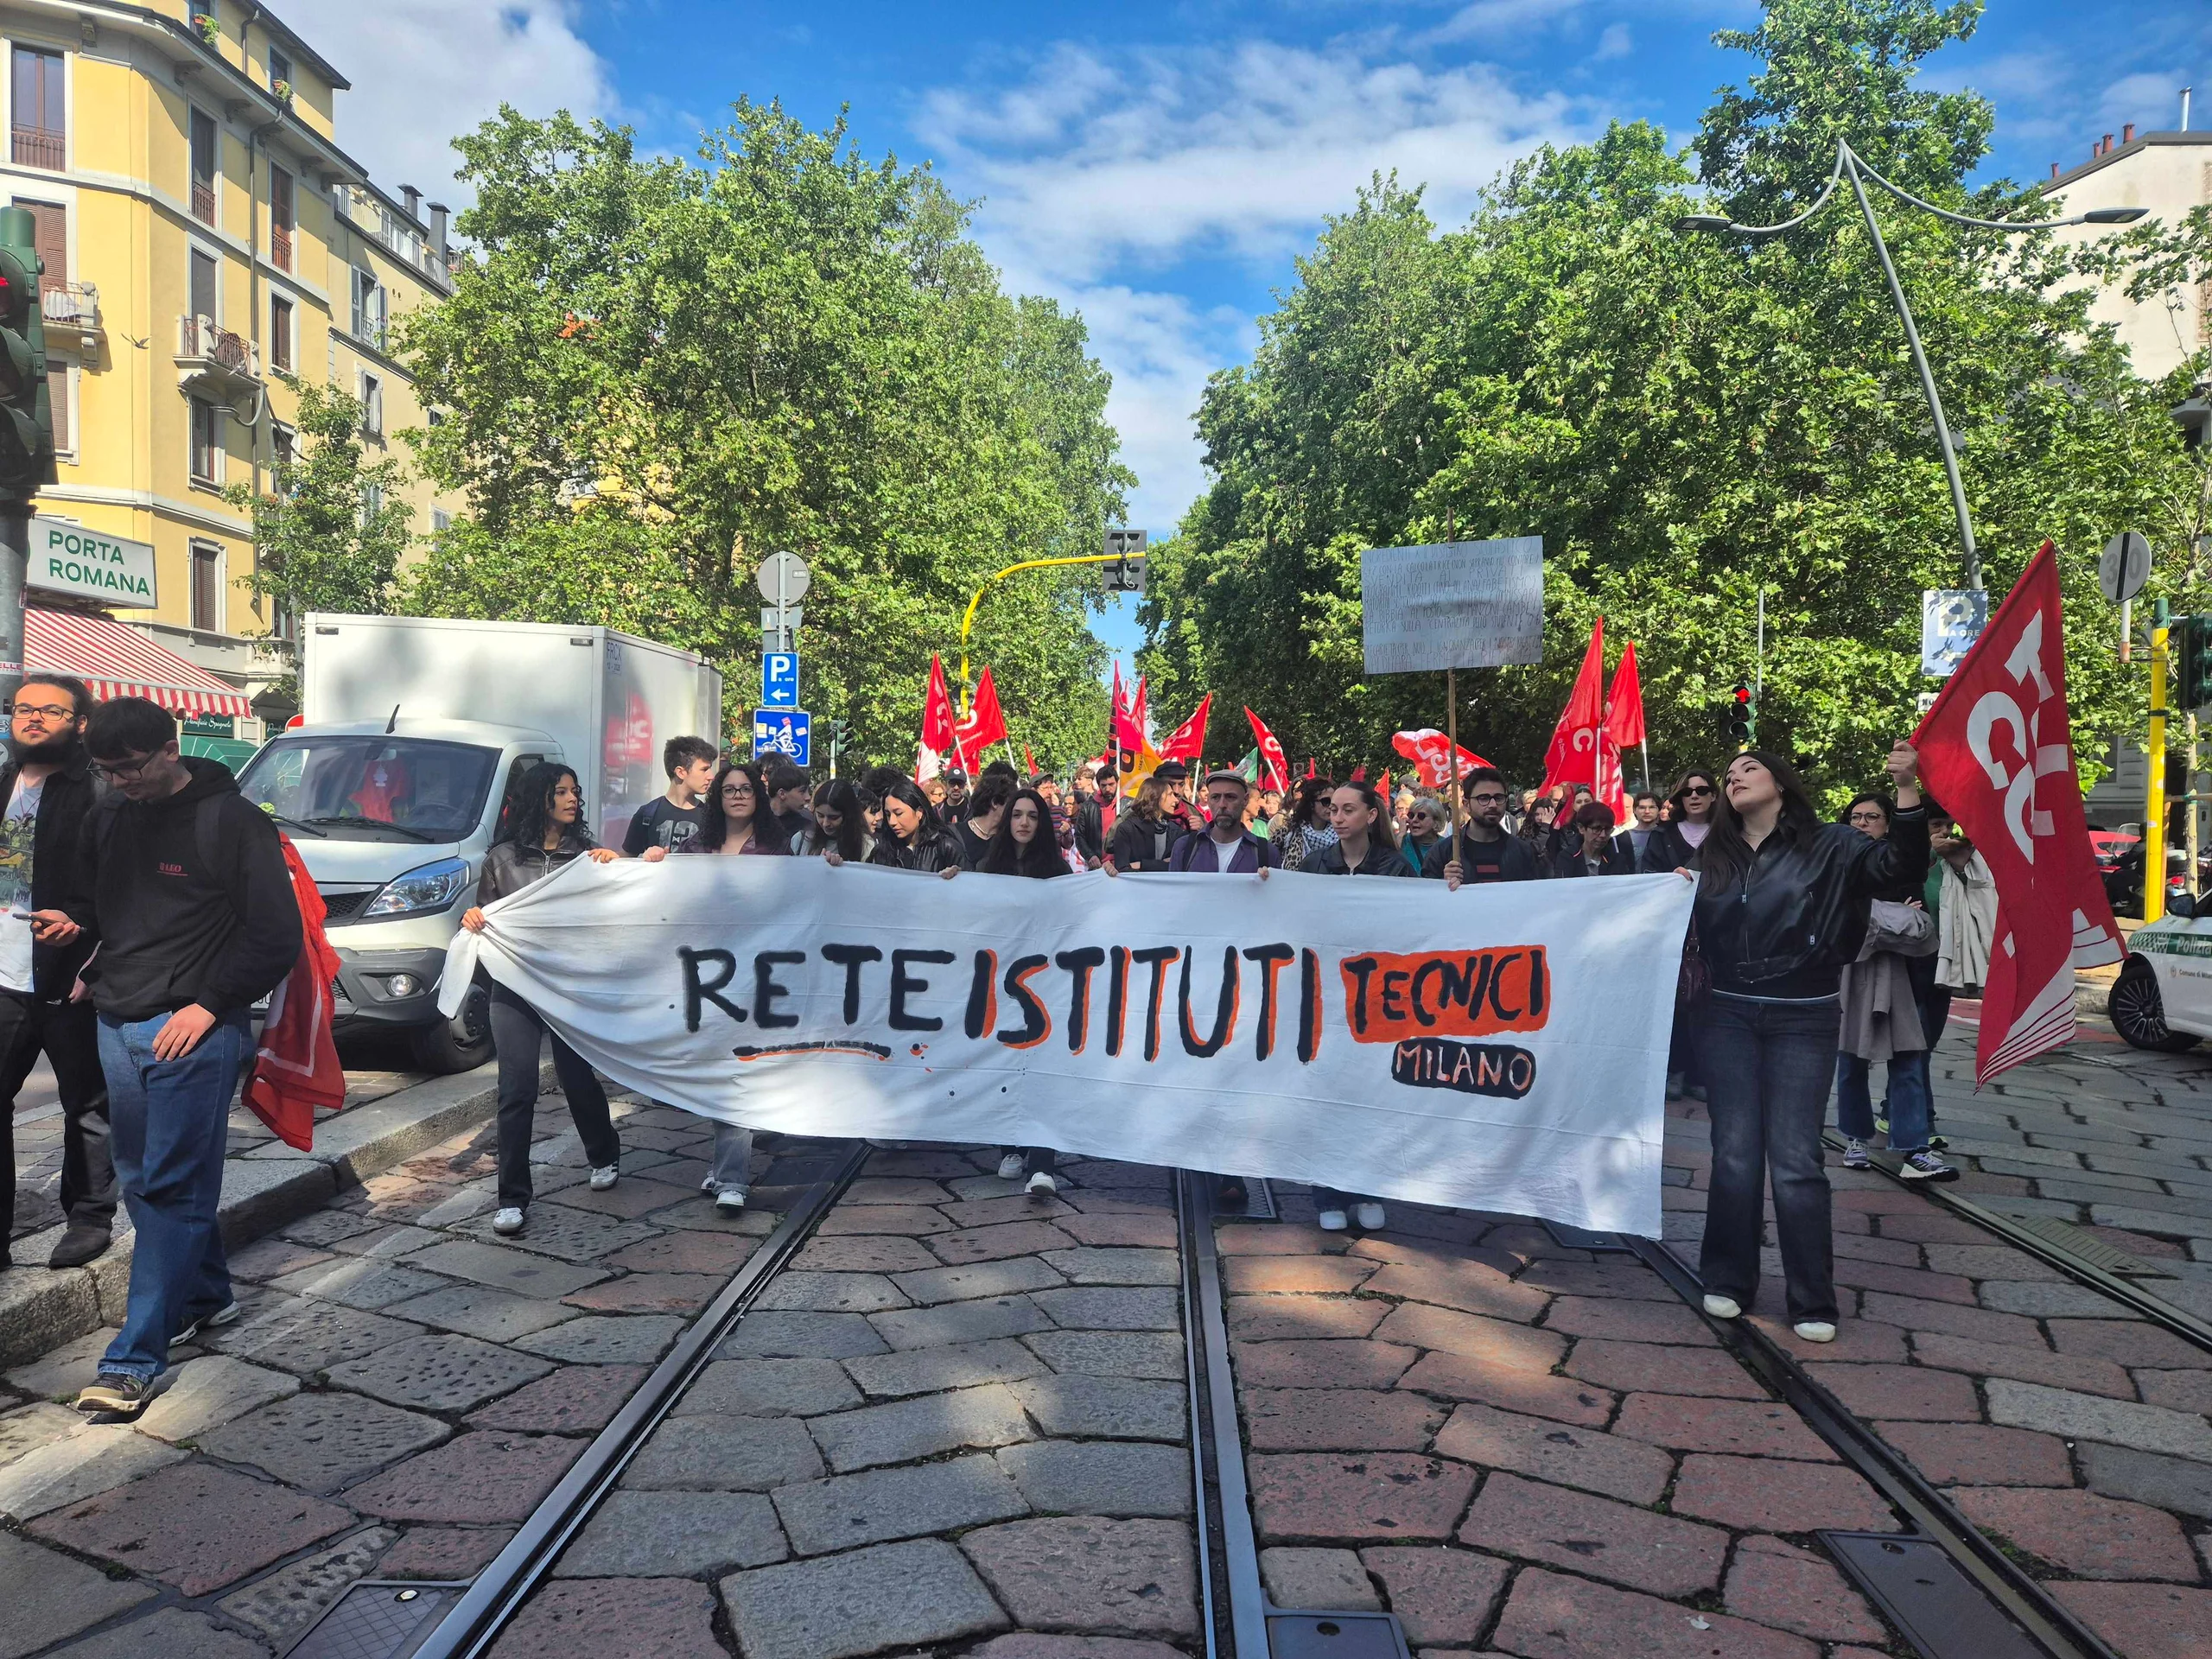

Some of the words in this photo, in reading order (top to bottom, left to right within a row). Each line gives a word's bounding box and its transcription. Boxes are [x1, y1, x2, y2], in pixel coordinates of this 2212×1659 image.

[48, 530, 125, 565] PORTA
[2106, 547, 2142, 585] 30
[49, 557, 151, 596] ROMANA
[1469, 563, 1522, 579] PRIVATI
[1937, 595, 1974, 637] P
[771, 657, 790, 682] P
[2176, 936, 2212, 955] Polizia
[679, 944, 955, 1033] RETE
[965, 944, 1321, 1063] ISTITUTI
[1348, 950, 1543, 1033] TECNICI
[1395, 1042, 1528, 1092] MILANO
